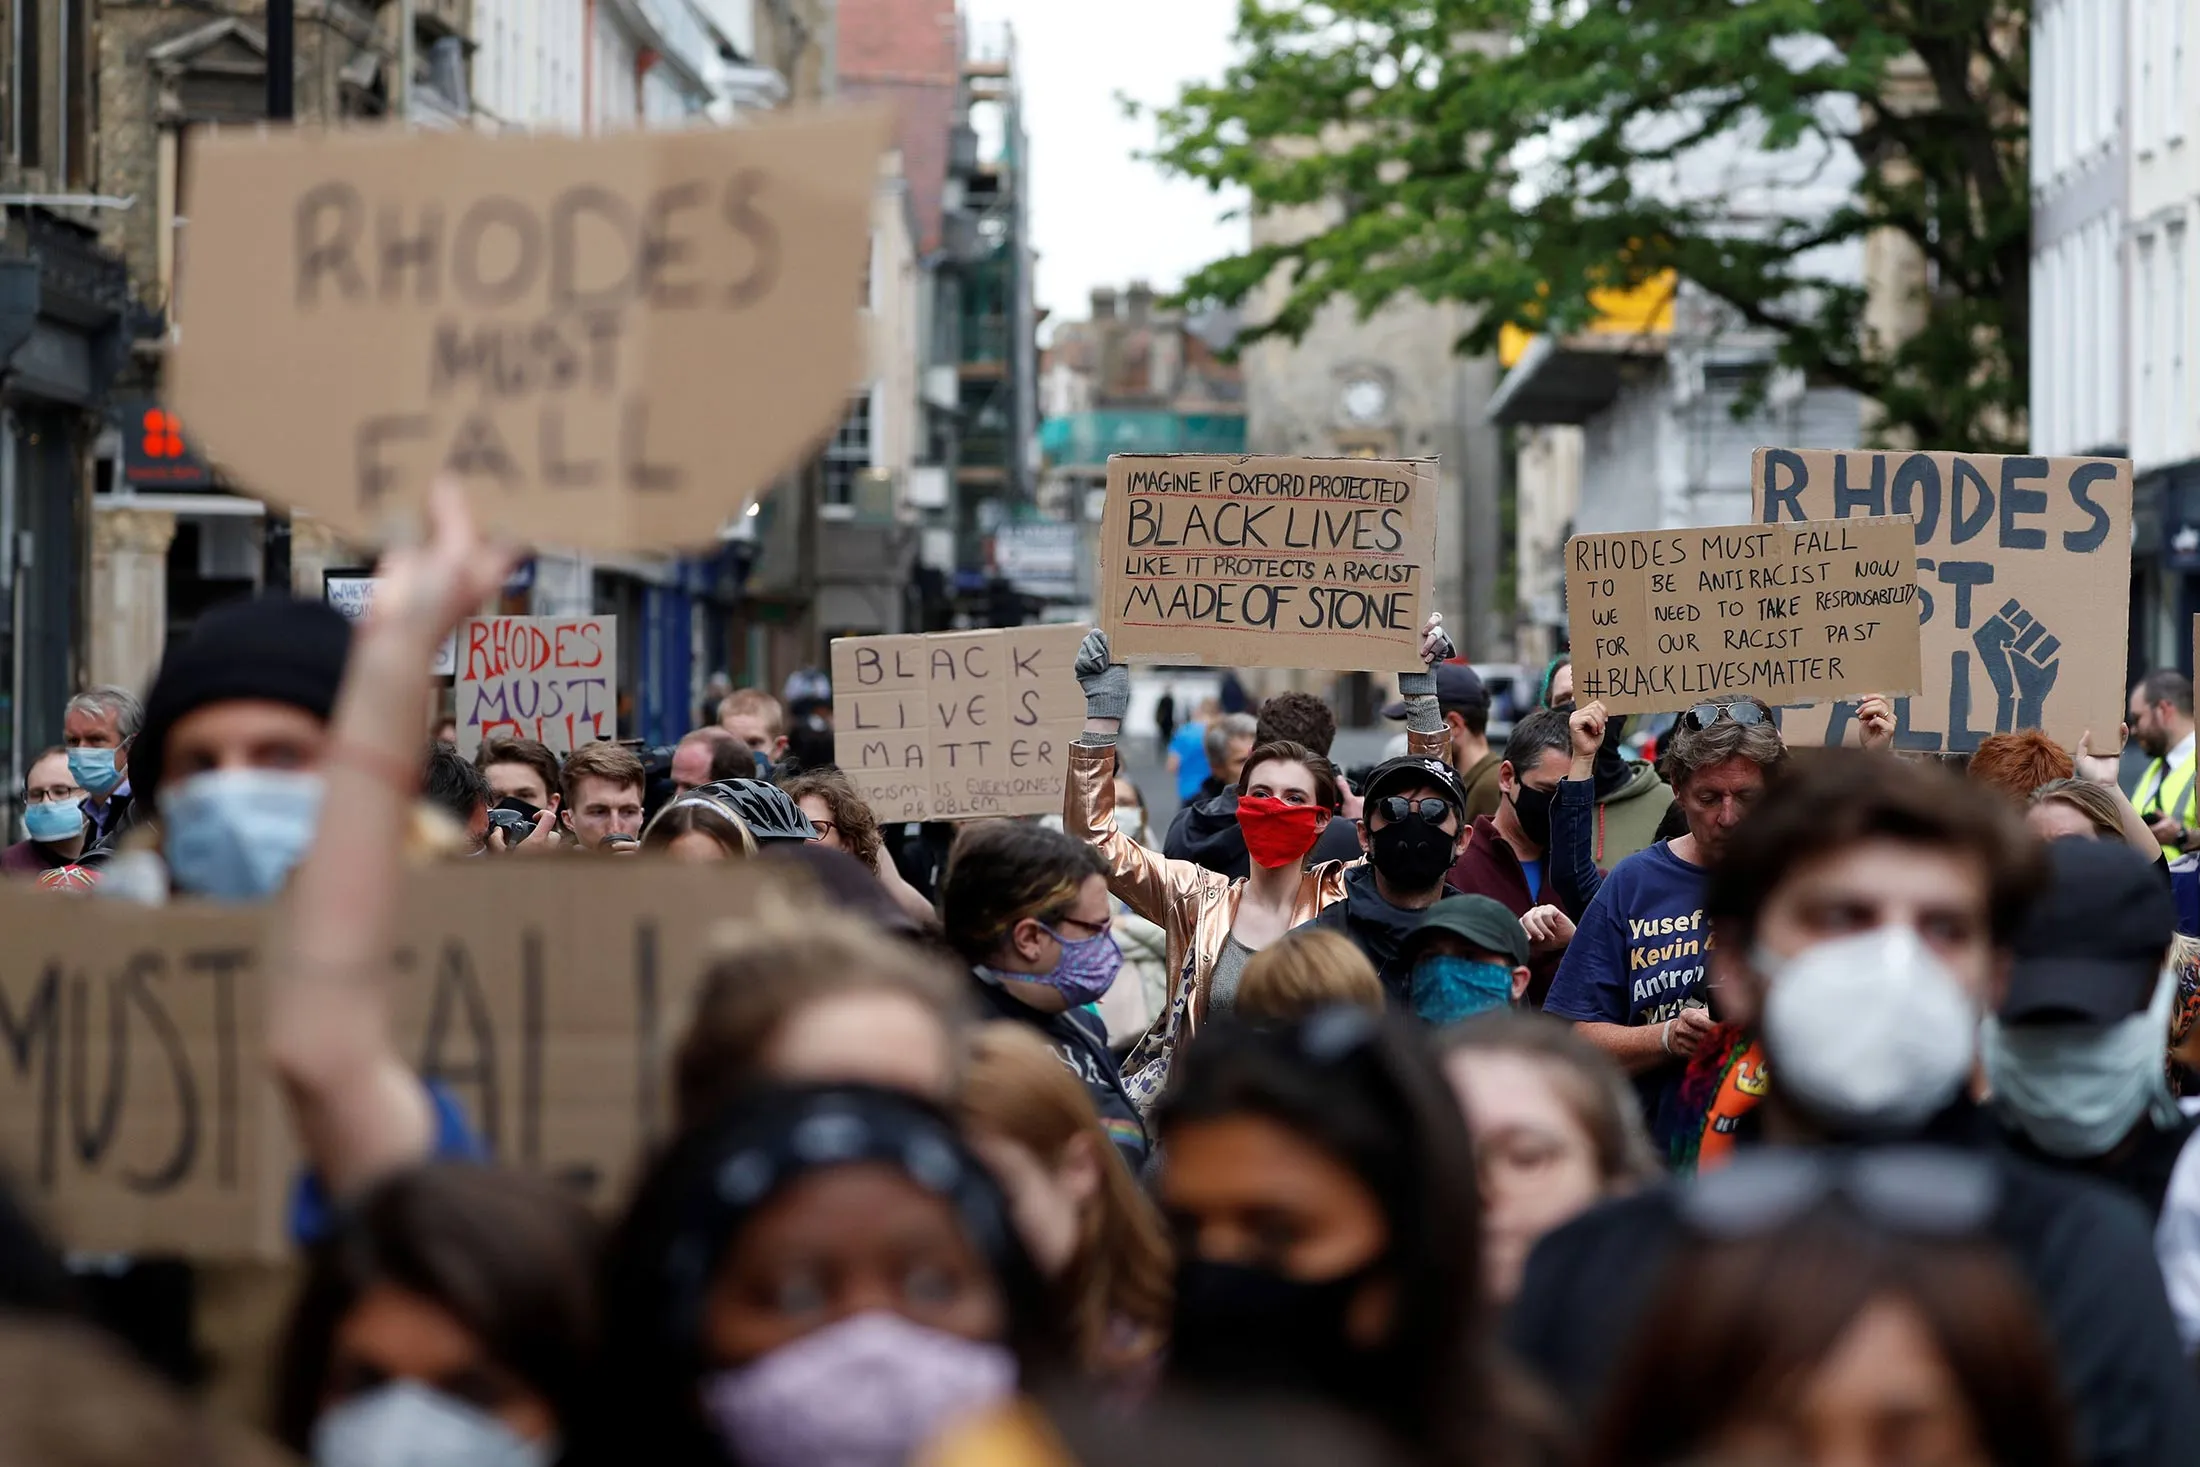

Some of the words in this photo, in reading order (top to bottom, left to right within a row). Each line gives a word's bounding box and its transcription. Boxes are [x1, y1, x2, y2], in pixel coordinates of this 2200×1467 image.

[293, 168, 784, 313] RHODES
[428, 305, 624, 399] MUST
[353, 397, 690, 512] FALL
[1127, 471, 1202, 494] IMAGINE
[1209, 470, 1225, 493] IF
[1228, 472, 1304, 497] OXFORD
[1309, 475, 1410, 504] PROTECTED
[1763, 448, 2118, 554] RHODES
[1127, 499, 1276, 548] BLACK
[1284, 507, 1404, 552] LIVES
[1125, 556, 1177, 575] LIKE
[1186, 556, 1208, 576] IT
[1213, 557, 1316, 580] PROTECTS
[1324, 562, 1337, 580] A
[1343, 561, 1421, 583] RACIST
[1576, 538, 1687, 572] RHODES
[1702, 533, 1774, 561] MUST
[1794, 528, 1858, 556] FALL
[1587, 578, 1615, 599] TO
[1651, 573, 1677, 593] BE
[1855, 560, 1900, 578] NOW
[1123, 583, 1238, 623] MADE
[1242, 583, 1299, 630] OF
[1298, 586, 1414, 630] STONE
[1592, 608, 1619, 626] WE
[1654, 604, 1701, 622] NEED
[1717, 600, 1744, 618] TO
[1757, 595, 1801, 621] TAKE
[1815, 583, 1918, 612] RESPONSABILITY
[463, 619, 604, 682] RHODES
[1595, 636, 1630, 659] FOR
[1658, 633, 1700, 654] OUR
[1723, 627, 1804, 650] RACIST
[1824, 622, 1881, 644] PAST
[854, 645, 1043, 685] BLACK
[1582, 656, 1845, 699] #BLACKLIVESMATTER
[467, 678, 606, 726] MUST
[854, 690, 1041, 728] LIVES
[862, 739, 1054, 768] MATTER
[1628, 909, 1704, 940] Yusef
[1630, 937, 1699, 971] Kevin
